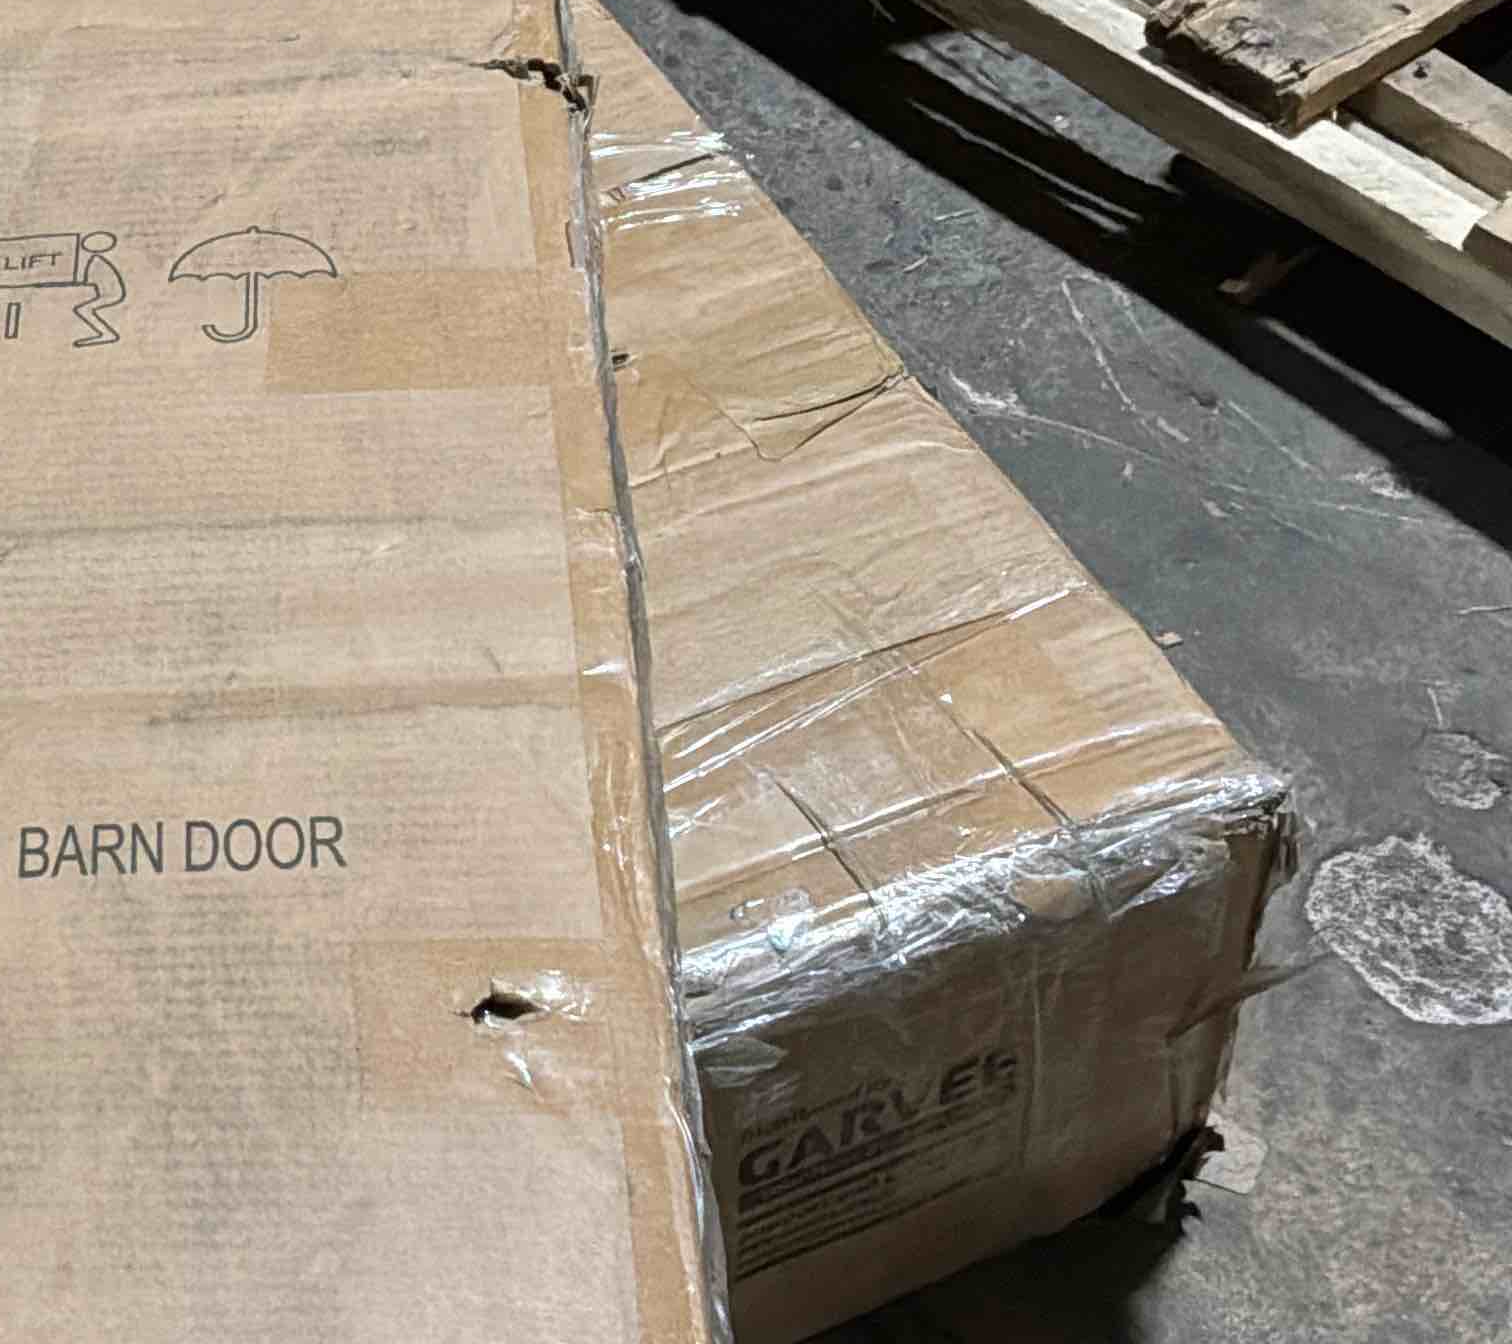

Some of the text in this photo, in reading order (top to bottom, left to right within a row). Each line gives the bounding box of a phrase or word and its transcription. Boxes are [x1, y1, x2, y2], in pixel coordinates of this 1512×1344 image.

[4, 250, 63, 270] LIFT
[18, 821, 164, 879] BARN
[184, 816, 348, 873] DOOR
